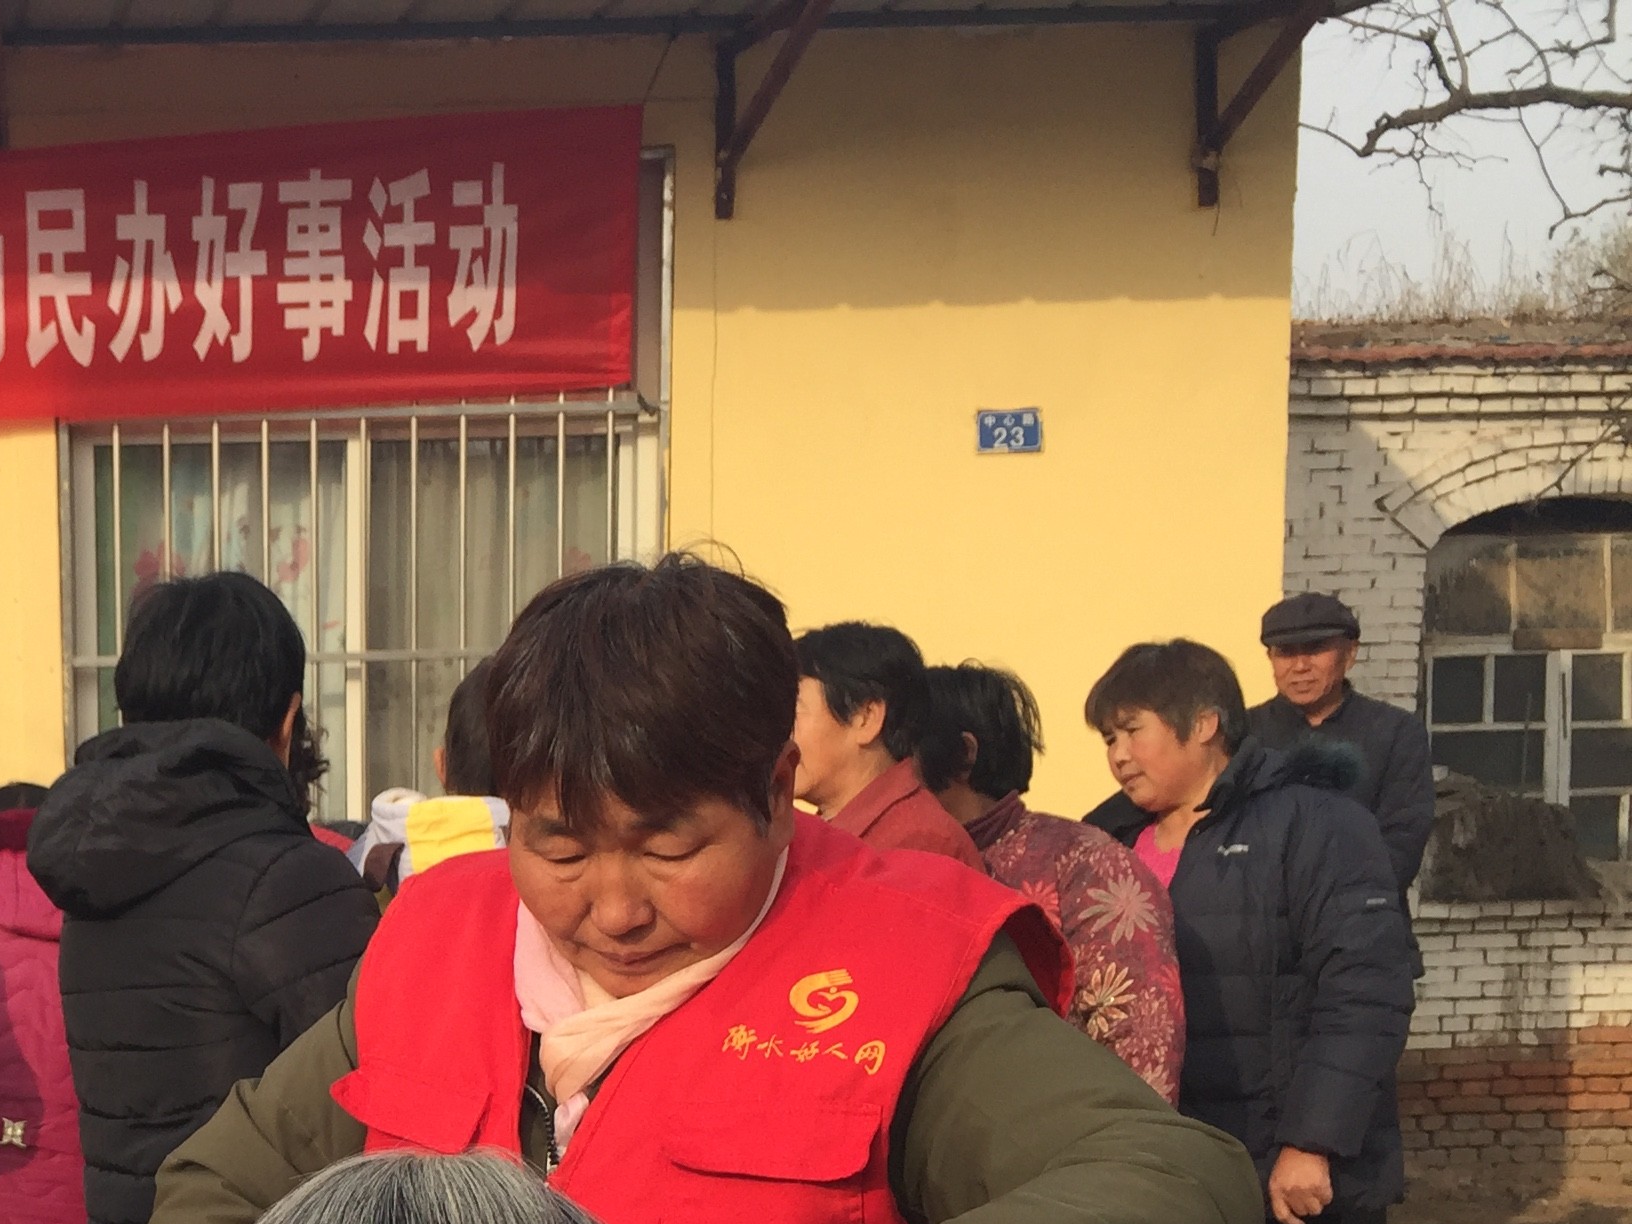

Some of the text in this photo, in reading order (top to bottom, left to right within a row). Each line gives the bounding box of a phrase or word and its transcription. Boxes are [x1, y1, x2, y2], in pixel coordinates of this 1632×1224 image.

[993, 426, 1024, 448] 23
[722, 1024, 886, 1075] 衡水好人网
